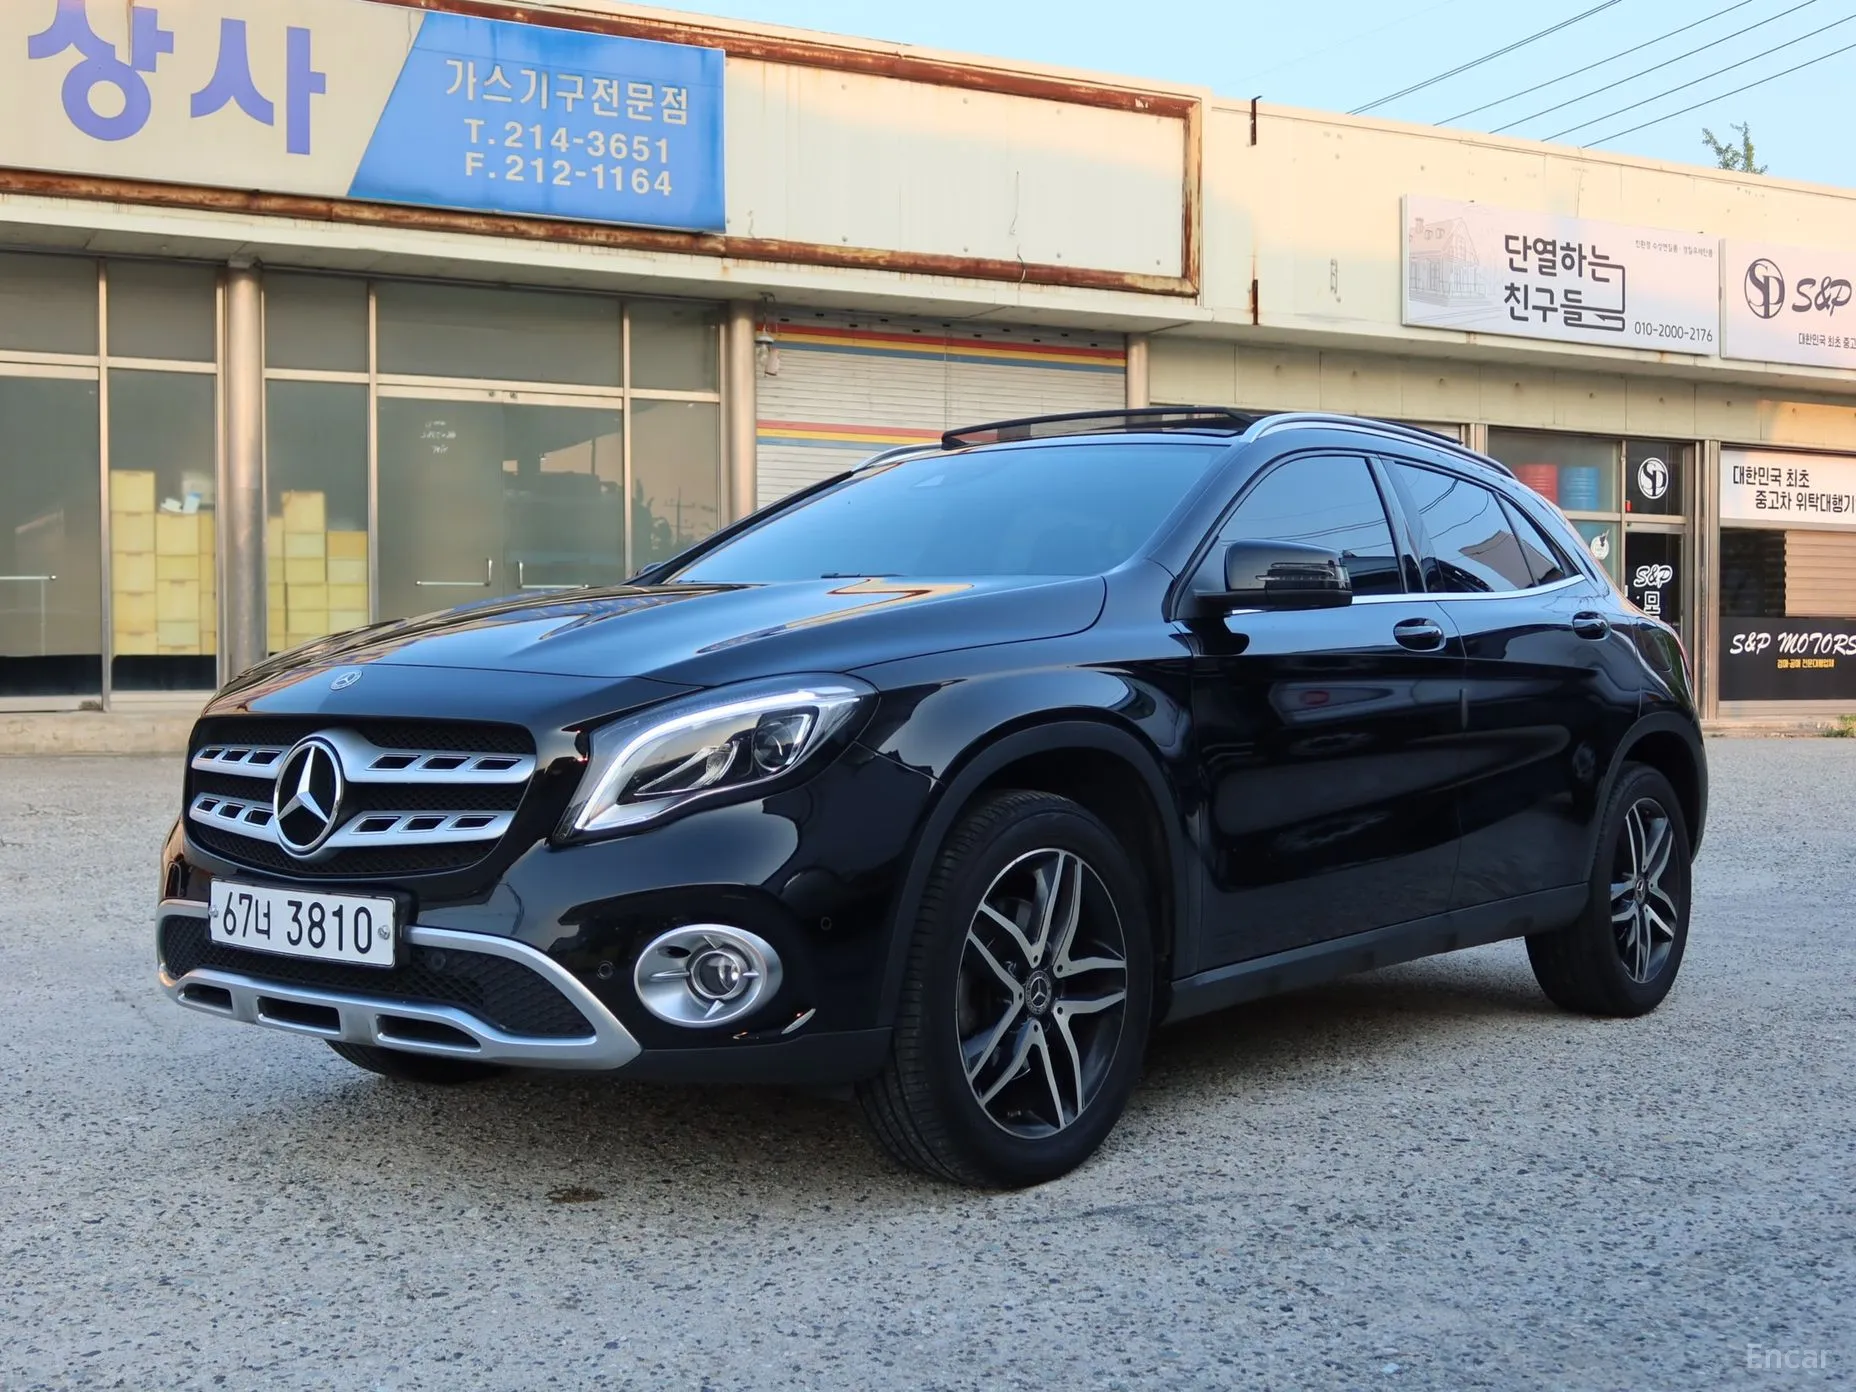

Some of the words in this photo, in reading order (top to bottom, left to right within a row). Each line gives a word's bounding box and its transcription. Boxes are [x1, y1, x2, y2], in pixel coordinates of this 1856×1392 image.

[27, 0, 327, 156] 상사
[446, 59, 688, 126] 가스기구전문점
[464, 118, 669, 164] T.214-3651
[465, 151, 673, 197] F.212-1164
[1504, 234, 1625, 283] 단열하는
[1504, 282, 1625, 331] 친구들
[1791, 276, 1852, 317] S&P
[1634, 321, 1713, 342] 010-2000-2176
[1798, 332, 1826, 347] 대한민국
[1827, 336, 1842, 349] 최초
[1733, 465, 1782, 487] 대한민국
[1786, 468, 1810, 488] 최초
[1755, 489, 1793, 511] 중고차
[1796, 492, 1856, 514] 위탁대행기
[1634, 565, 1673, 589] S&P
[1644, 591, 1661, 620] 모
[1729, 631, 1772, 655] S&P
[1777, 632, 1856, 656] MOTORS
[223, 891, 271, 941] 67너
[286, 899, 373, 955] 3810
